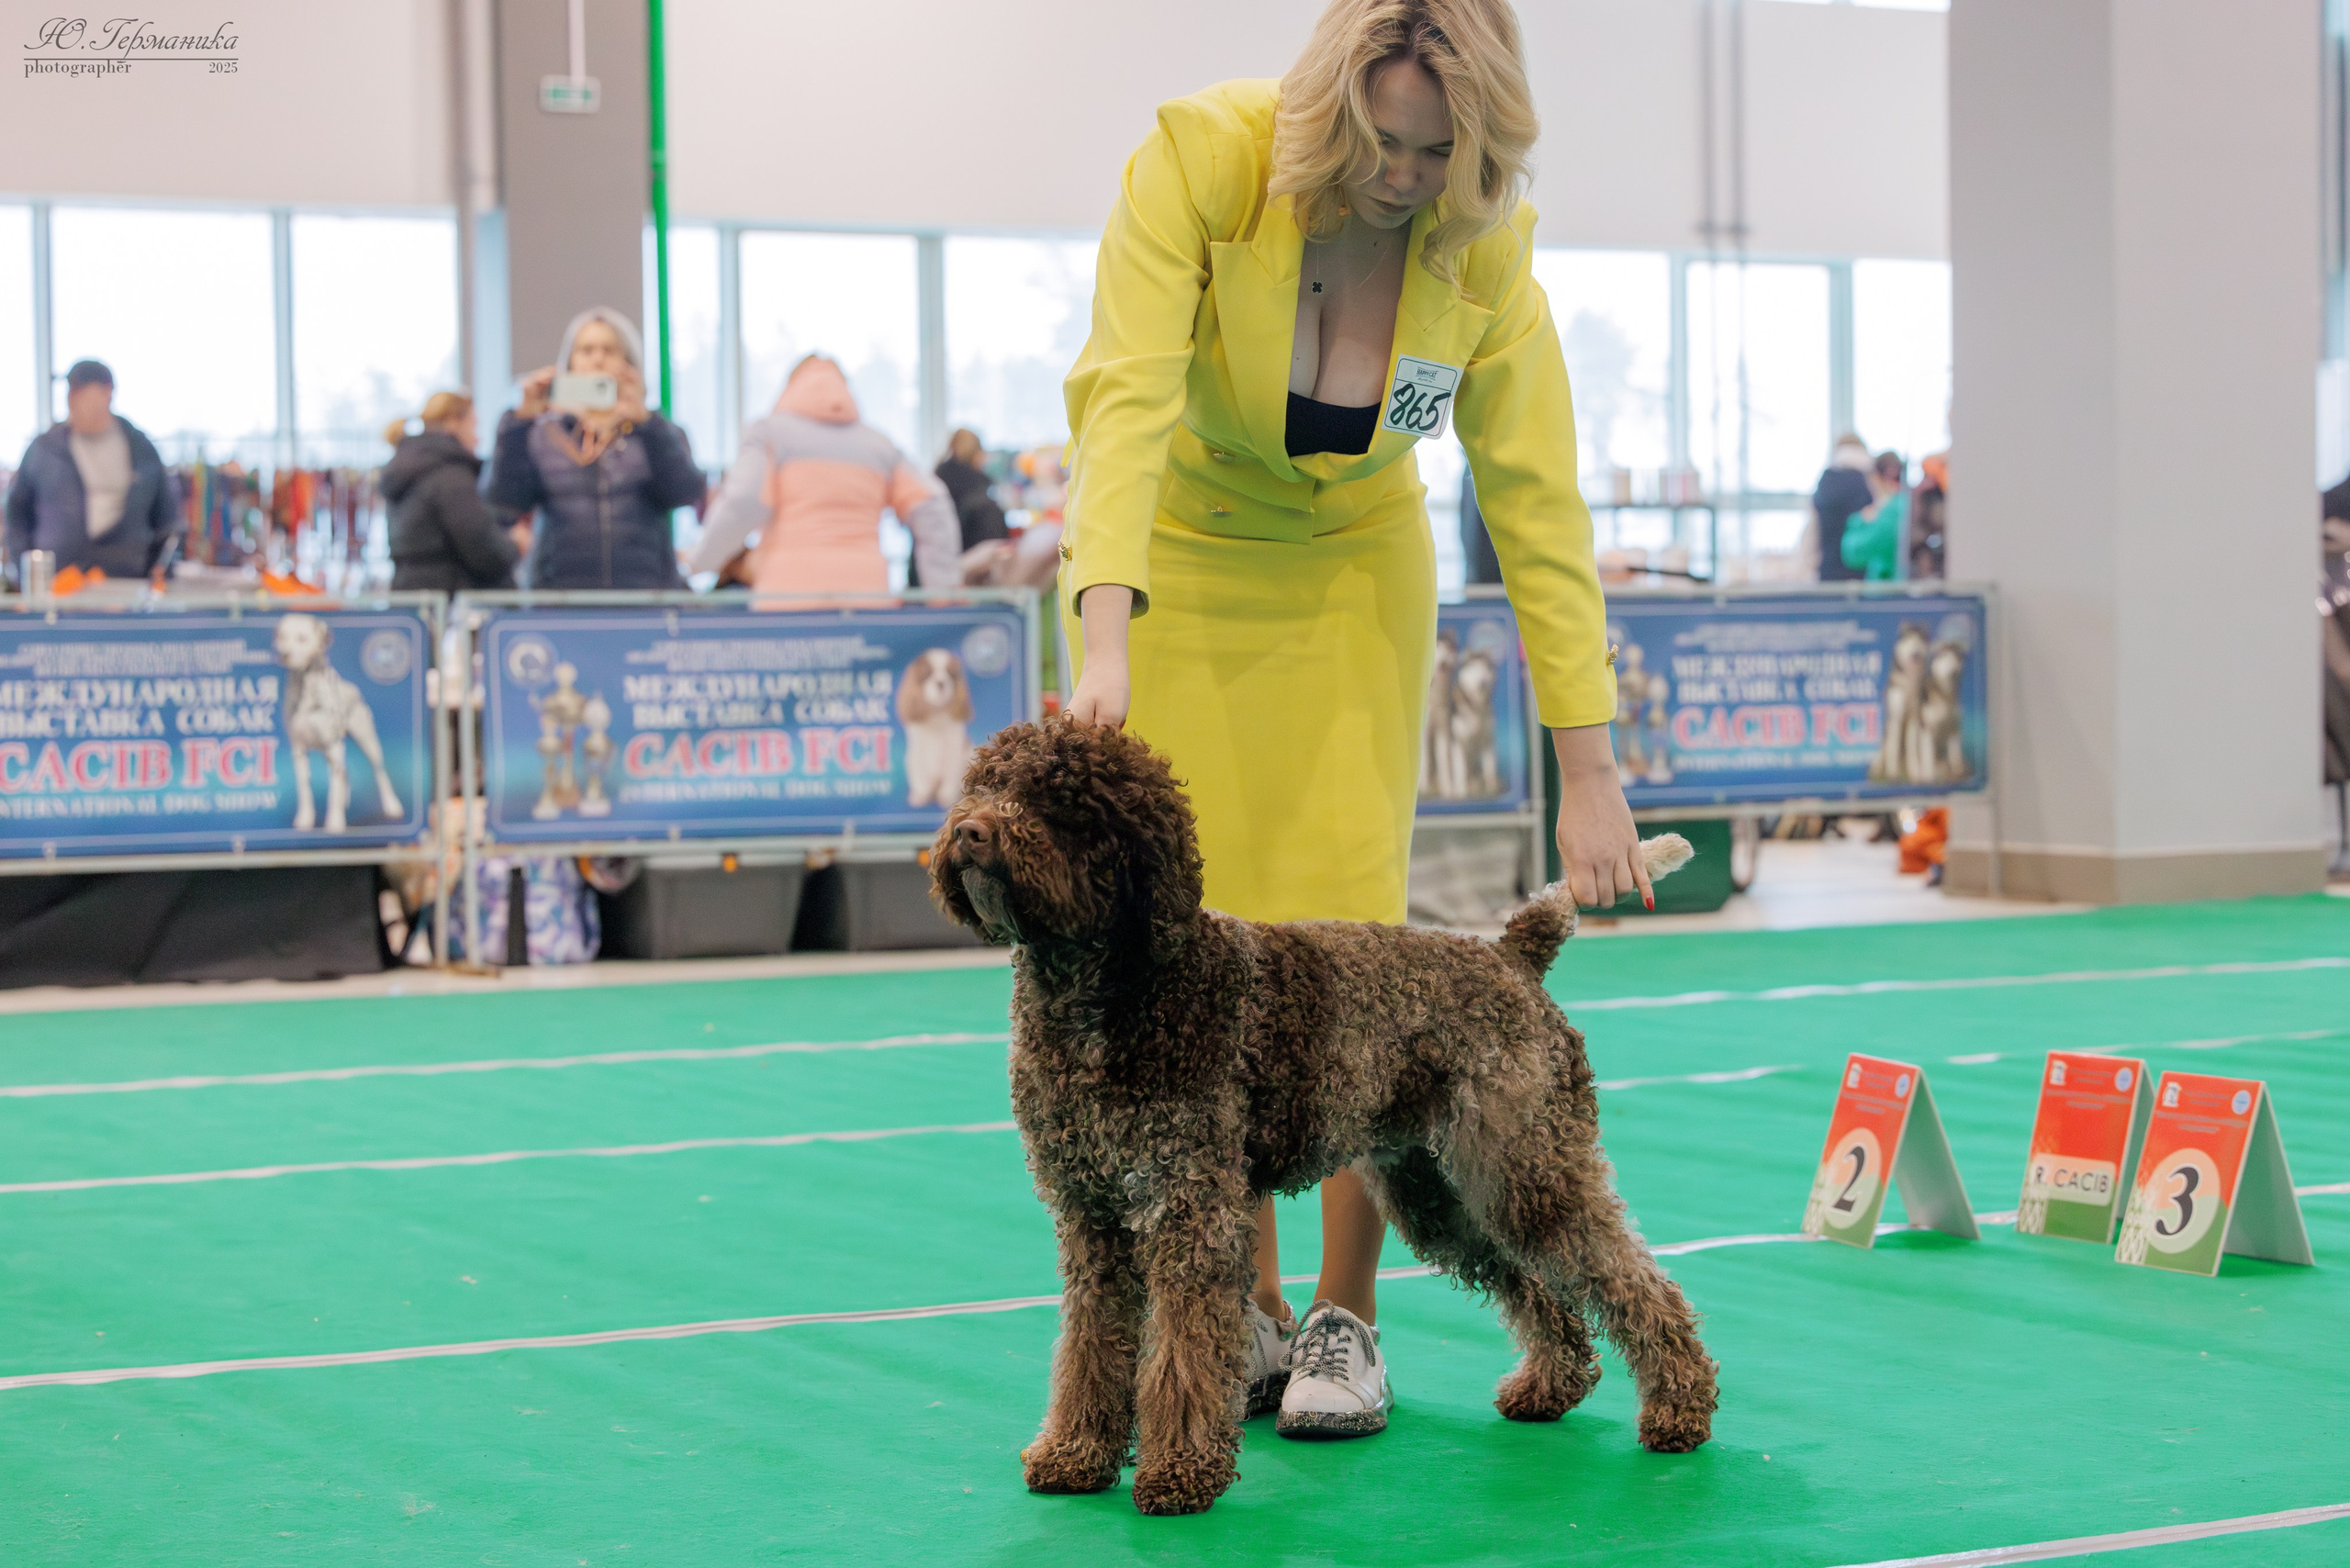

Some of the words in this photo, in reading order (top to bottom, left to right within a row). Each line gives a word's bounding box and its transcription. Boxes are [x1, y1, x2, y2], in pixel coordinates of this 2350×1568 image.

[1390, 384, 1451, 431] 865
[1673, 704, 1807, 749] CACIB
[1811, 702, 1880, 745] FCI
[0, 740, 173, 794] CACIB
[181, 737, 278, 788] FCI
[624, 731, 791, 778] CACIB
[800, 726, 893, 775] FCI
[1831, 1145, 1865, 1213] 2
[2053, 1169, 2109, 1193] CACIB
[2155, 1166, 2199, 1236] 3
